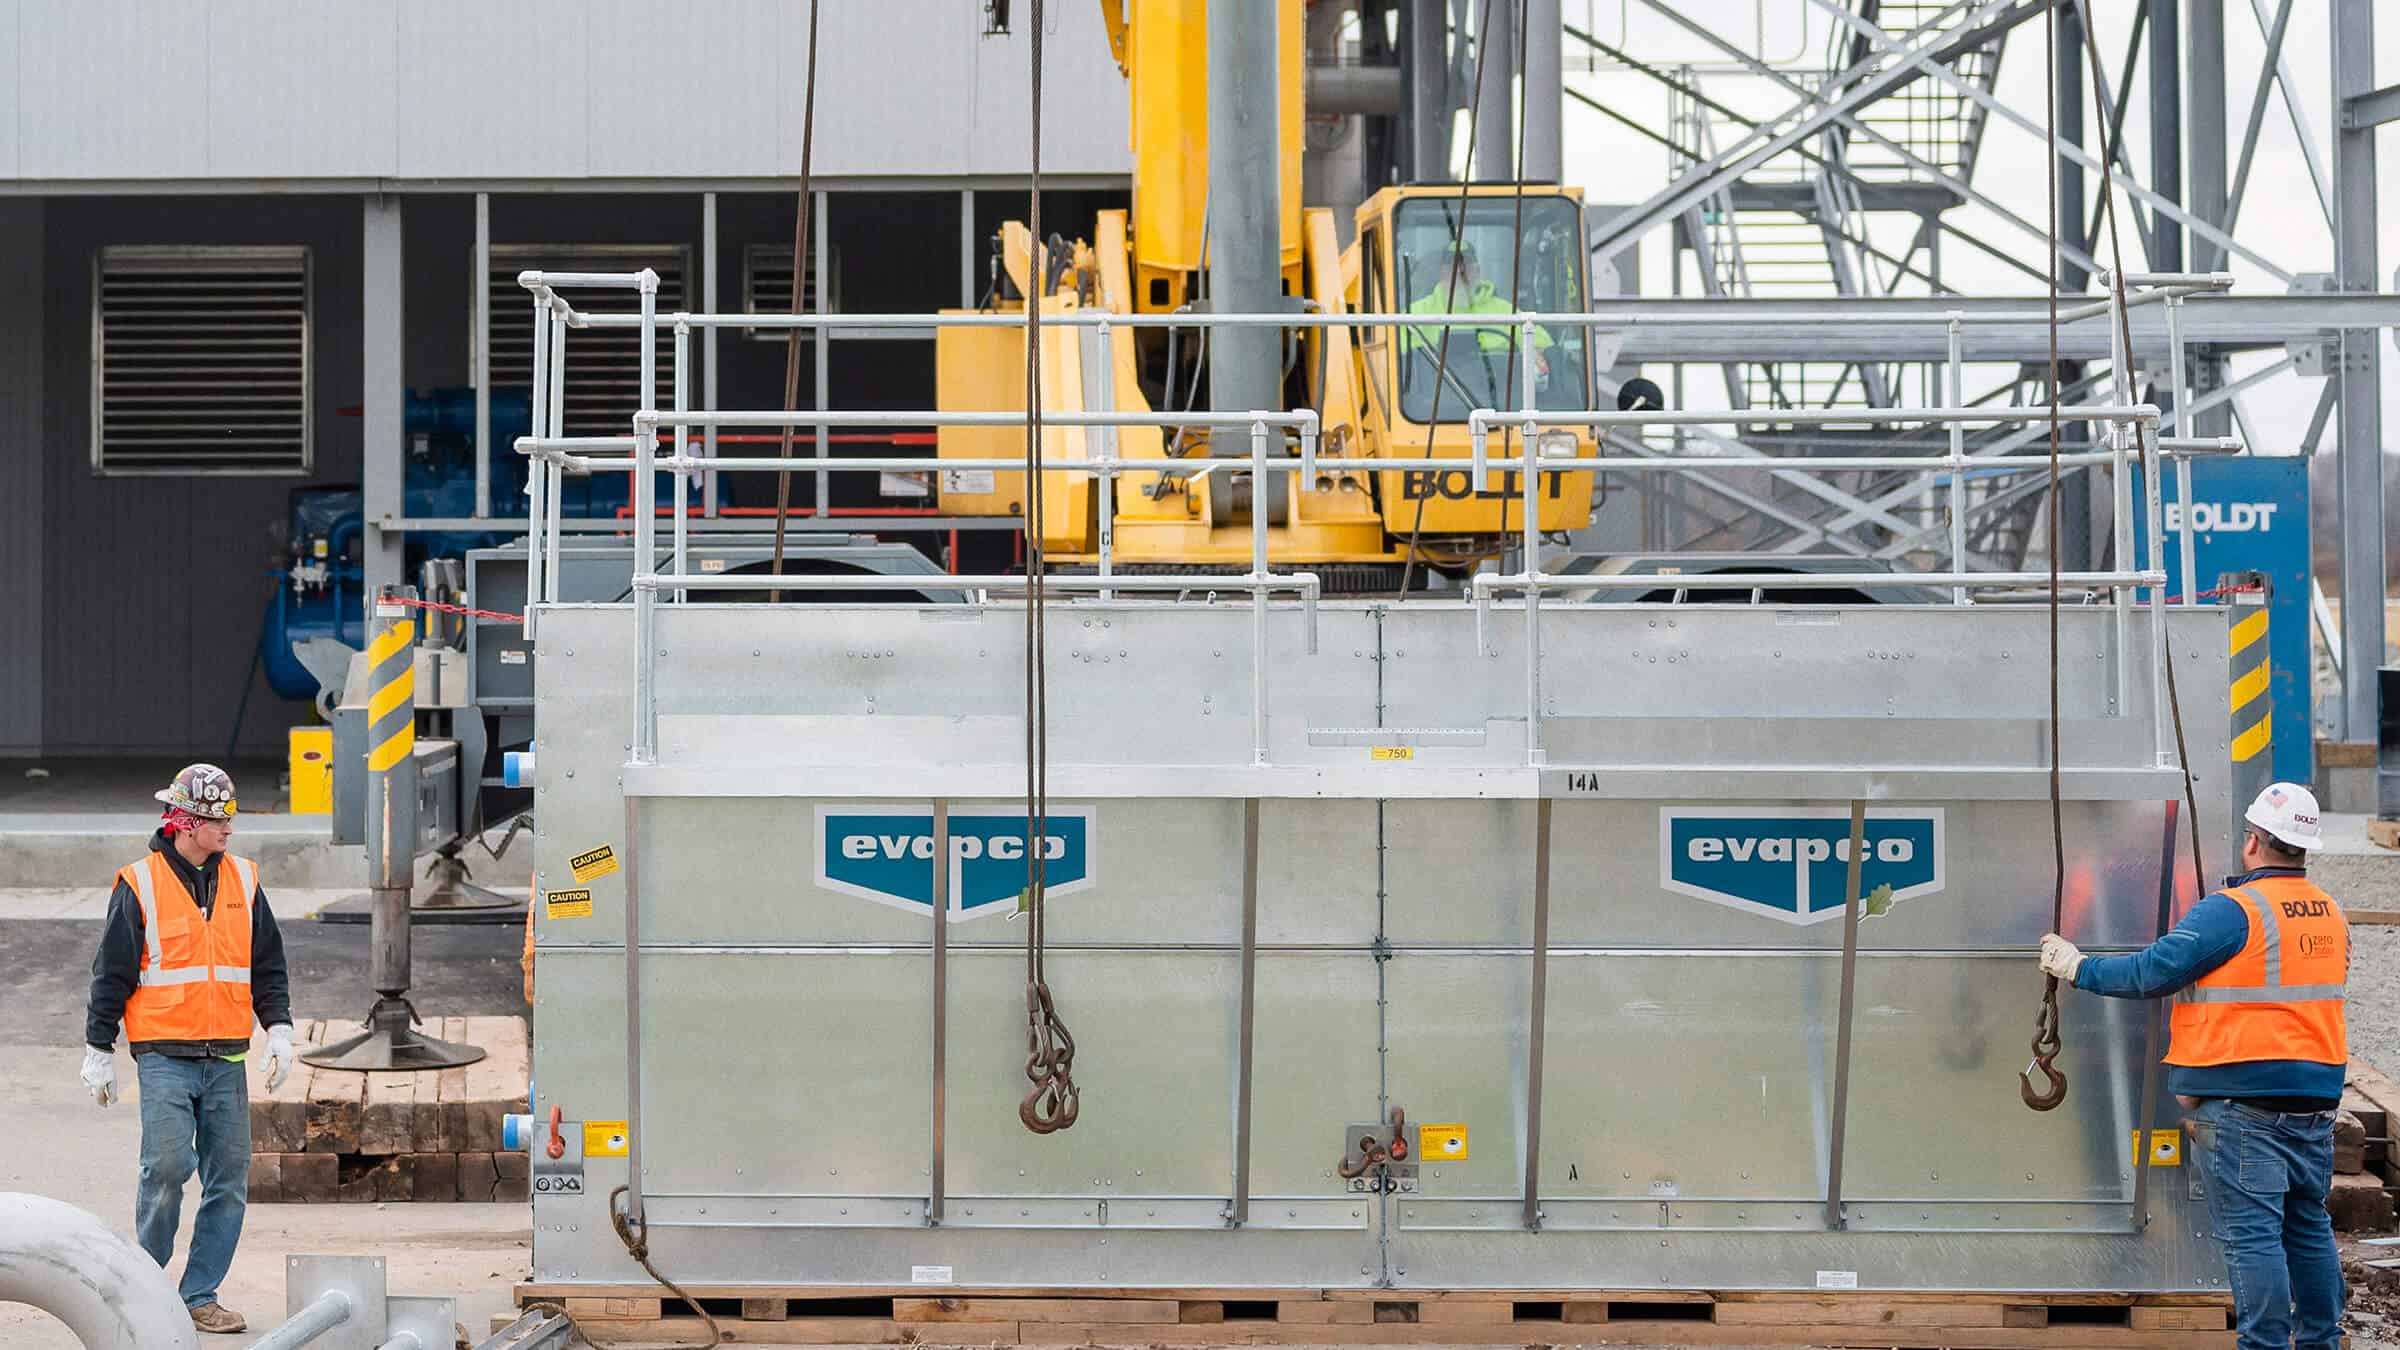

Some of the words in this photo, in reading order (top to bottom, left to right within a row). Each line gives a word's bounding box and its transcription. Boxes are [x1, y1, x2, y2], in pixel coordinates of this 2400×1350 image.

[2165, 502, 2277, 532] BOLDT
[1388, 748, 1408, 759] 750
[1568, 773, 1599, 791] 14A
[573, 847, 611, 867] CAUTION
[1688, 838, 1915, 863] evapco
[550, 892, 588, 903] CAUTION
[2280, 900, 2330, 918] BOLDT
